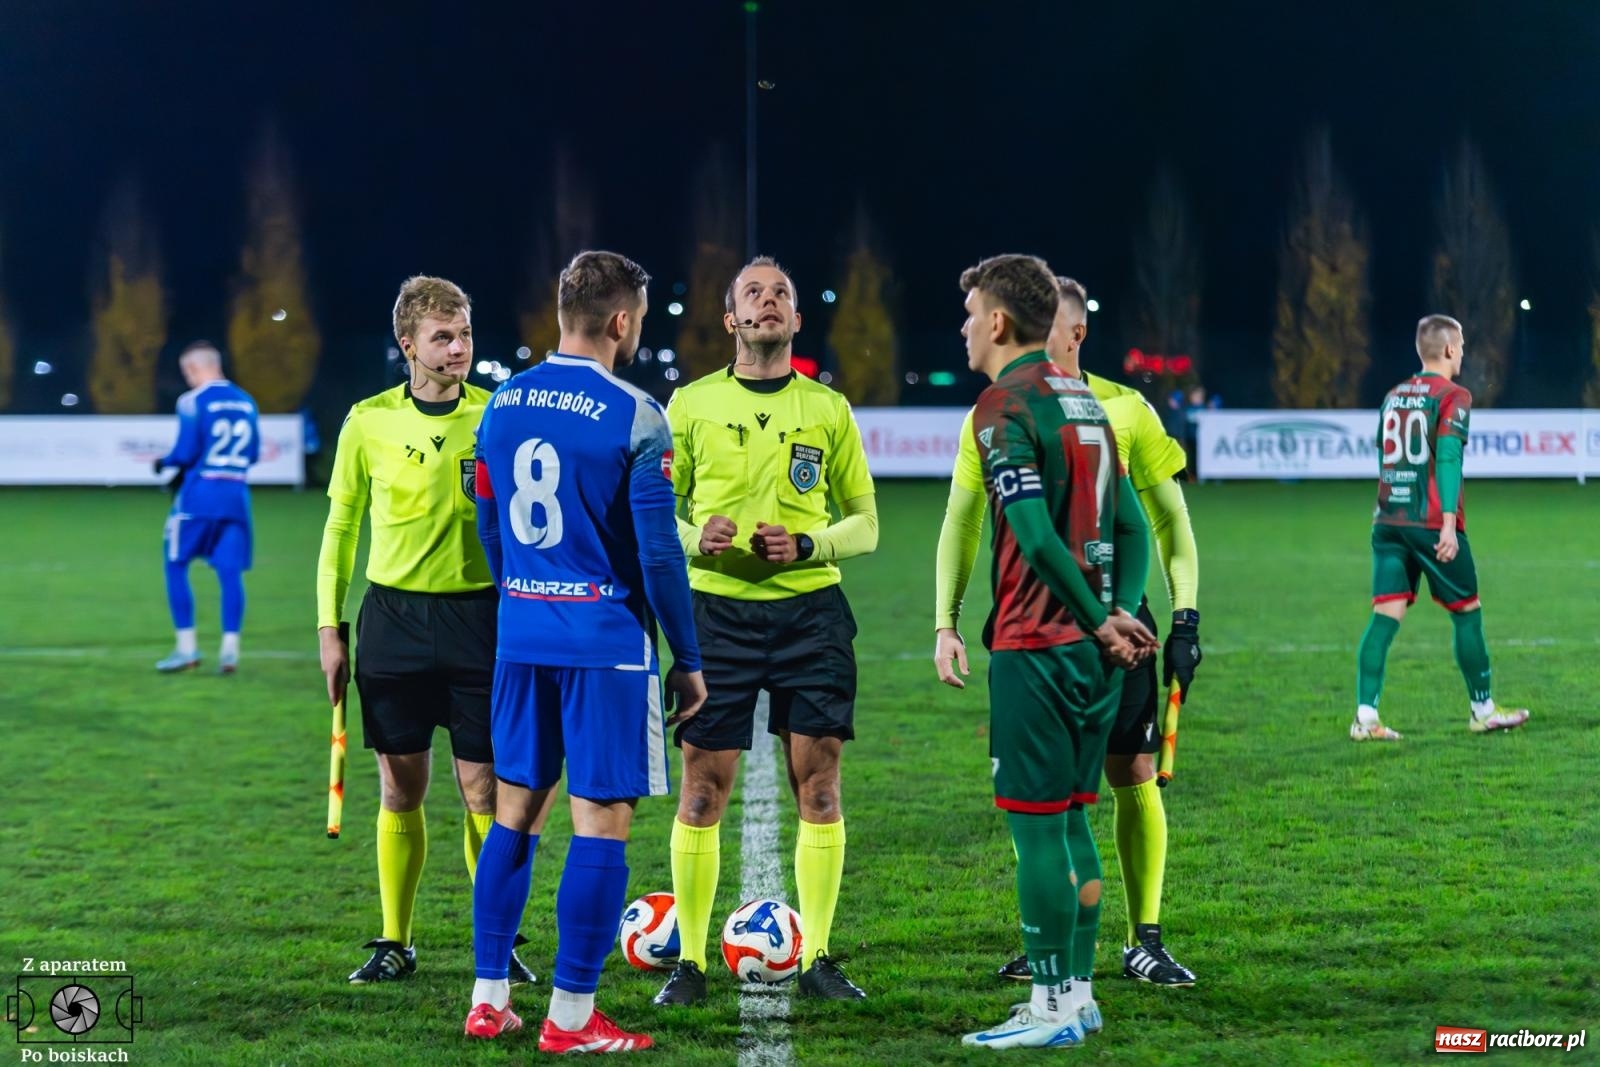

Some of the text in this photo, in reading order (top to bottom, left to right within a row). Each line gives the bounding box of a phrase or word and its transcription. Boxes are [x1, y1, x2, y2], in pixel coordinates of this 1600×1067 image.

[493, 388, 608, 421] UNIA RACIBÓRZ
[206, 418, 252, 468] 22
[860, 428, 959, 458] iasto
[1382, 410, 1430, 465] 80
[1465, 430, 1577, 457] TROLEX
[509, 438, 564, 549] 8
[1076, 425, 1111, 528] 7
